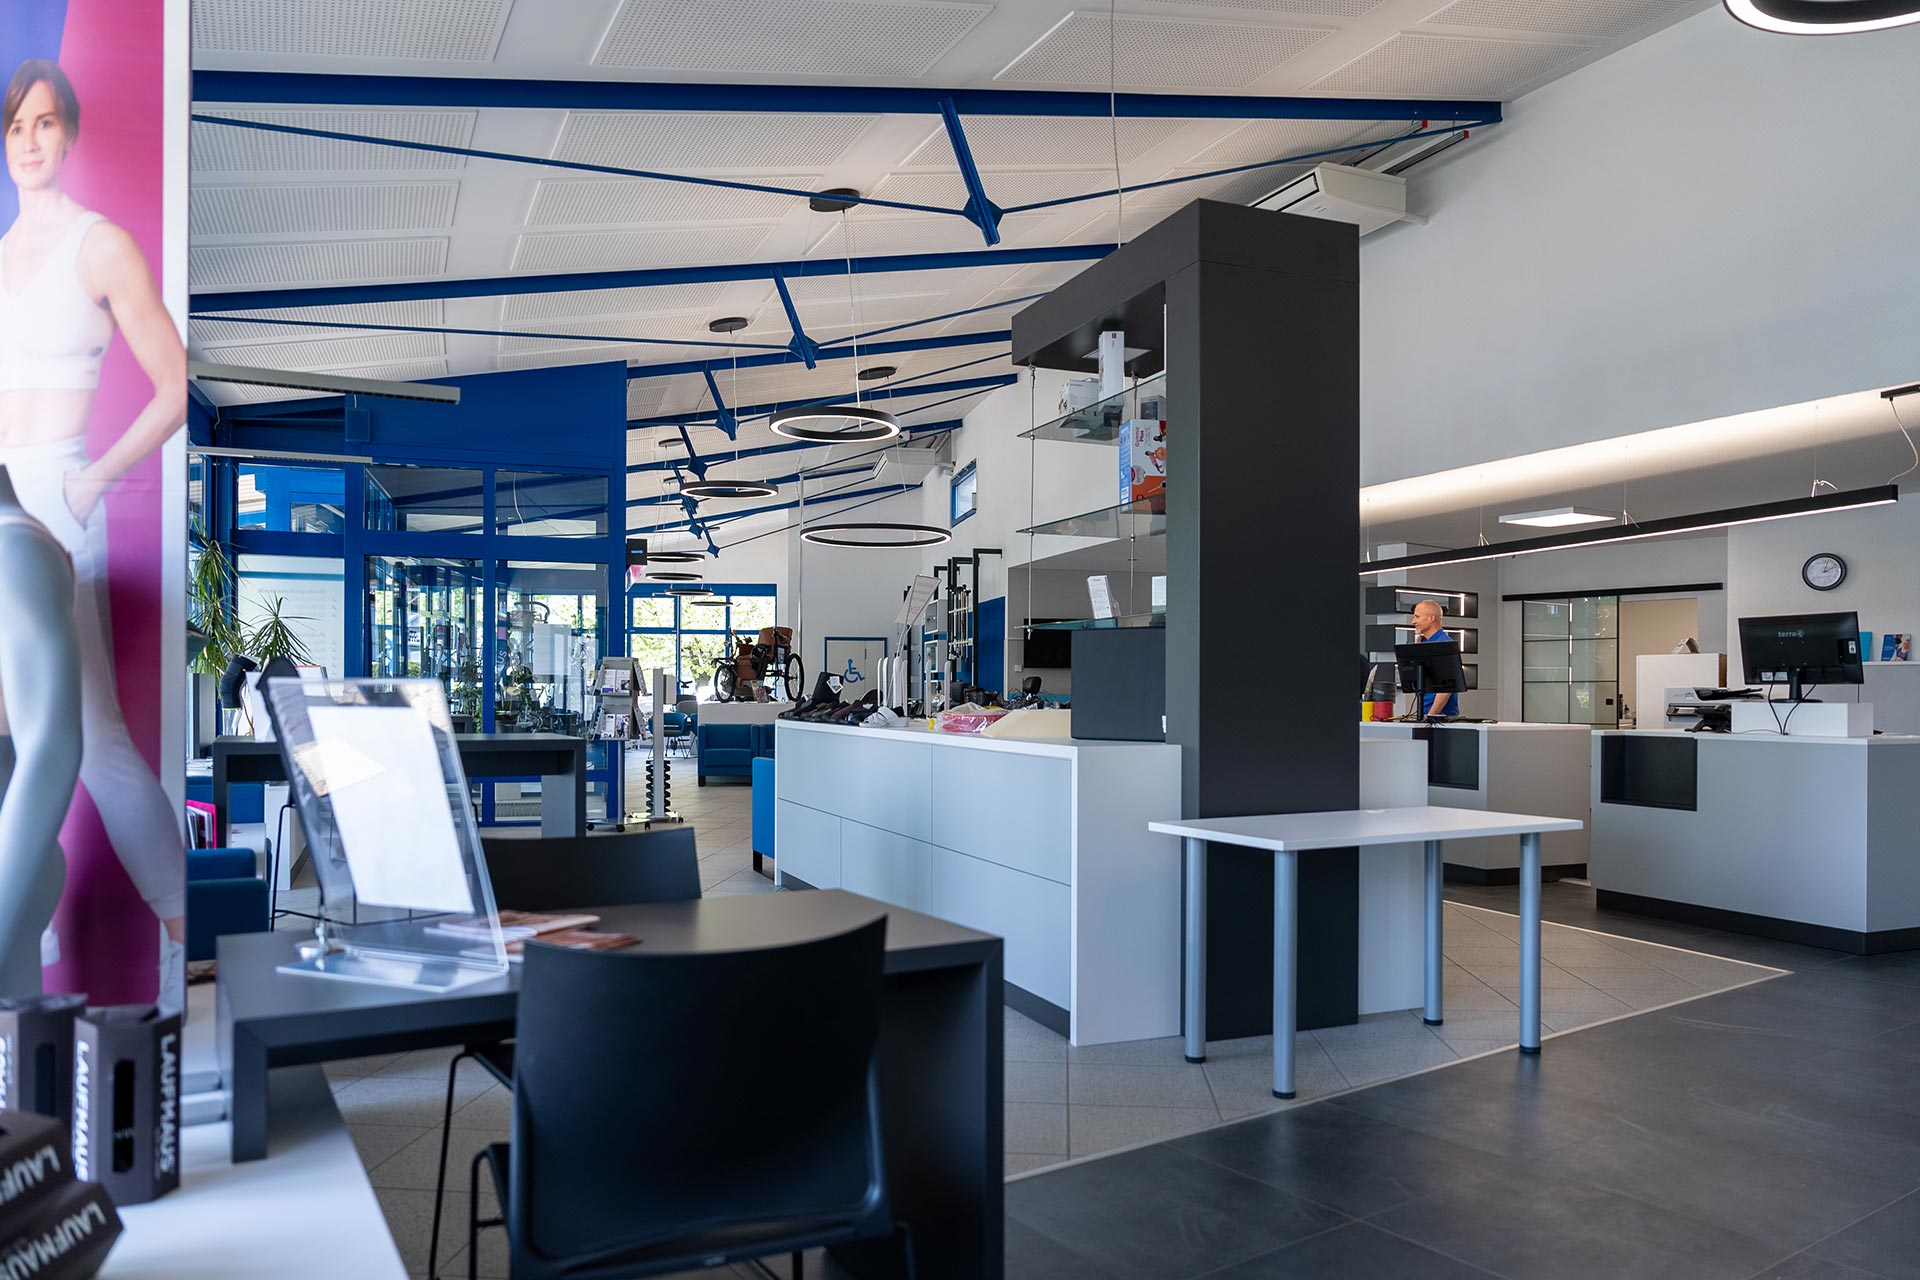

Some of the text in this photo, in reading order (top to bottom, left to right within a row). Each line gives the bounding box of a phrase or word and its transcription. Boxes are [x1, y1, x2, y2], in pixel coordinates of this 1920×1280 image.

[75, 1039, 90, 1182] LAUFMAUS
[160, 1033, 176, 1173] LAUFMAUS
[0, 1144, 62, 1206] LAUF
[0, 1200, 107, 1280] LAUFMAU
